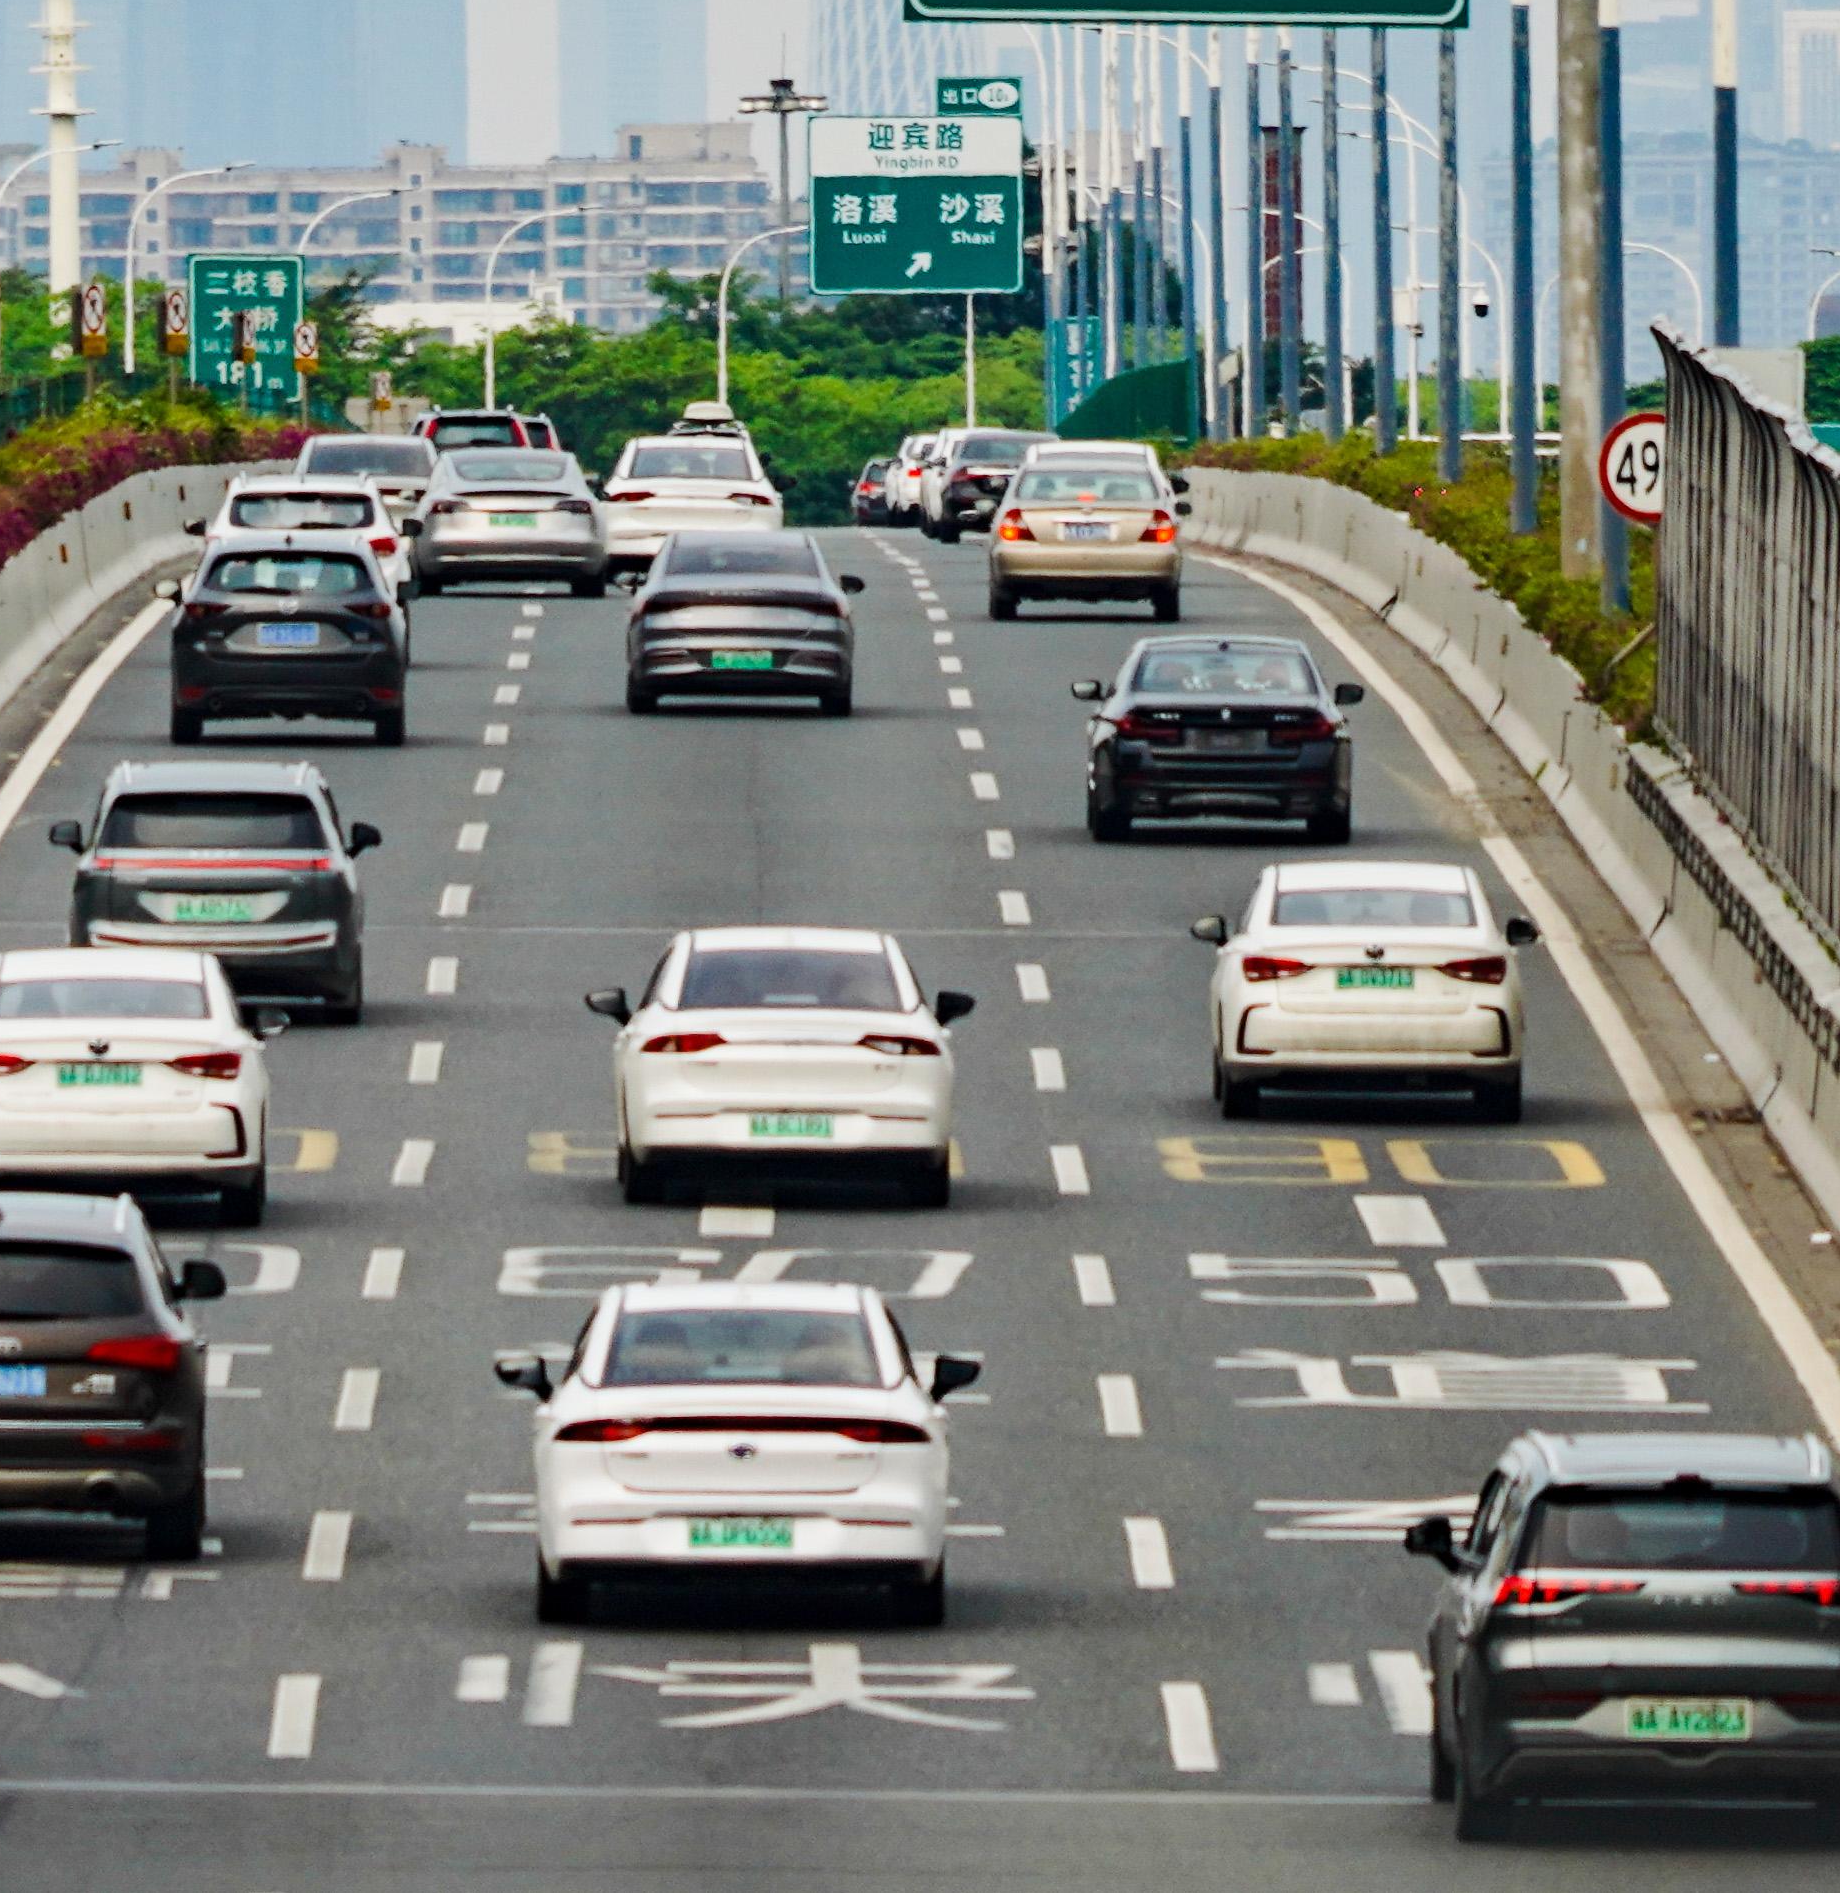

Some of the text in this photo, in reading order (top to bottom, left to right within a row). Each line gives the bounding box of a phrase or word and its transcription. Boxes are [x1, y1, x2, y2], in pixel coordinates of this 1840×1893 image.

[942, 88, 979, 105] 出口
[868, 122, 963, 151] 迎宾路
[874, 155, 959, 171] Yingbin RD
[832, 193, 899, 225] 洛溪
[939, 193, 1005, 225] 沙溪
[842, 229, 888, 245] Luoxi
[951, 229, 996, 245] Shaxi
[1616, 439, 1660, 496] 49
